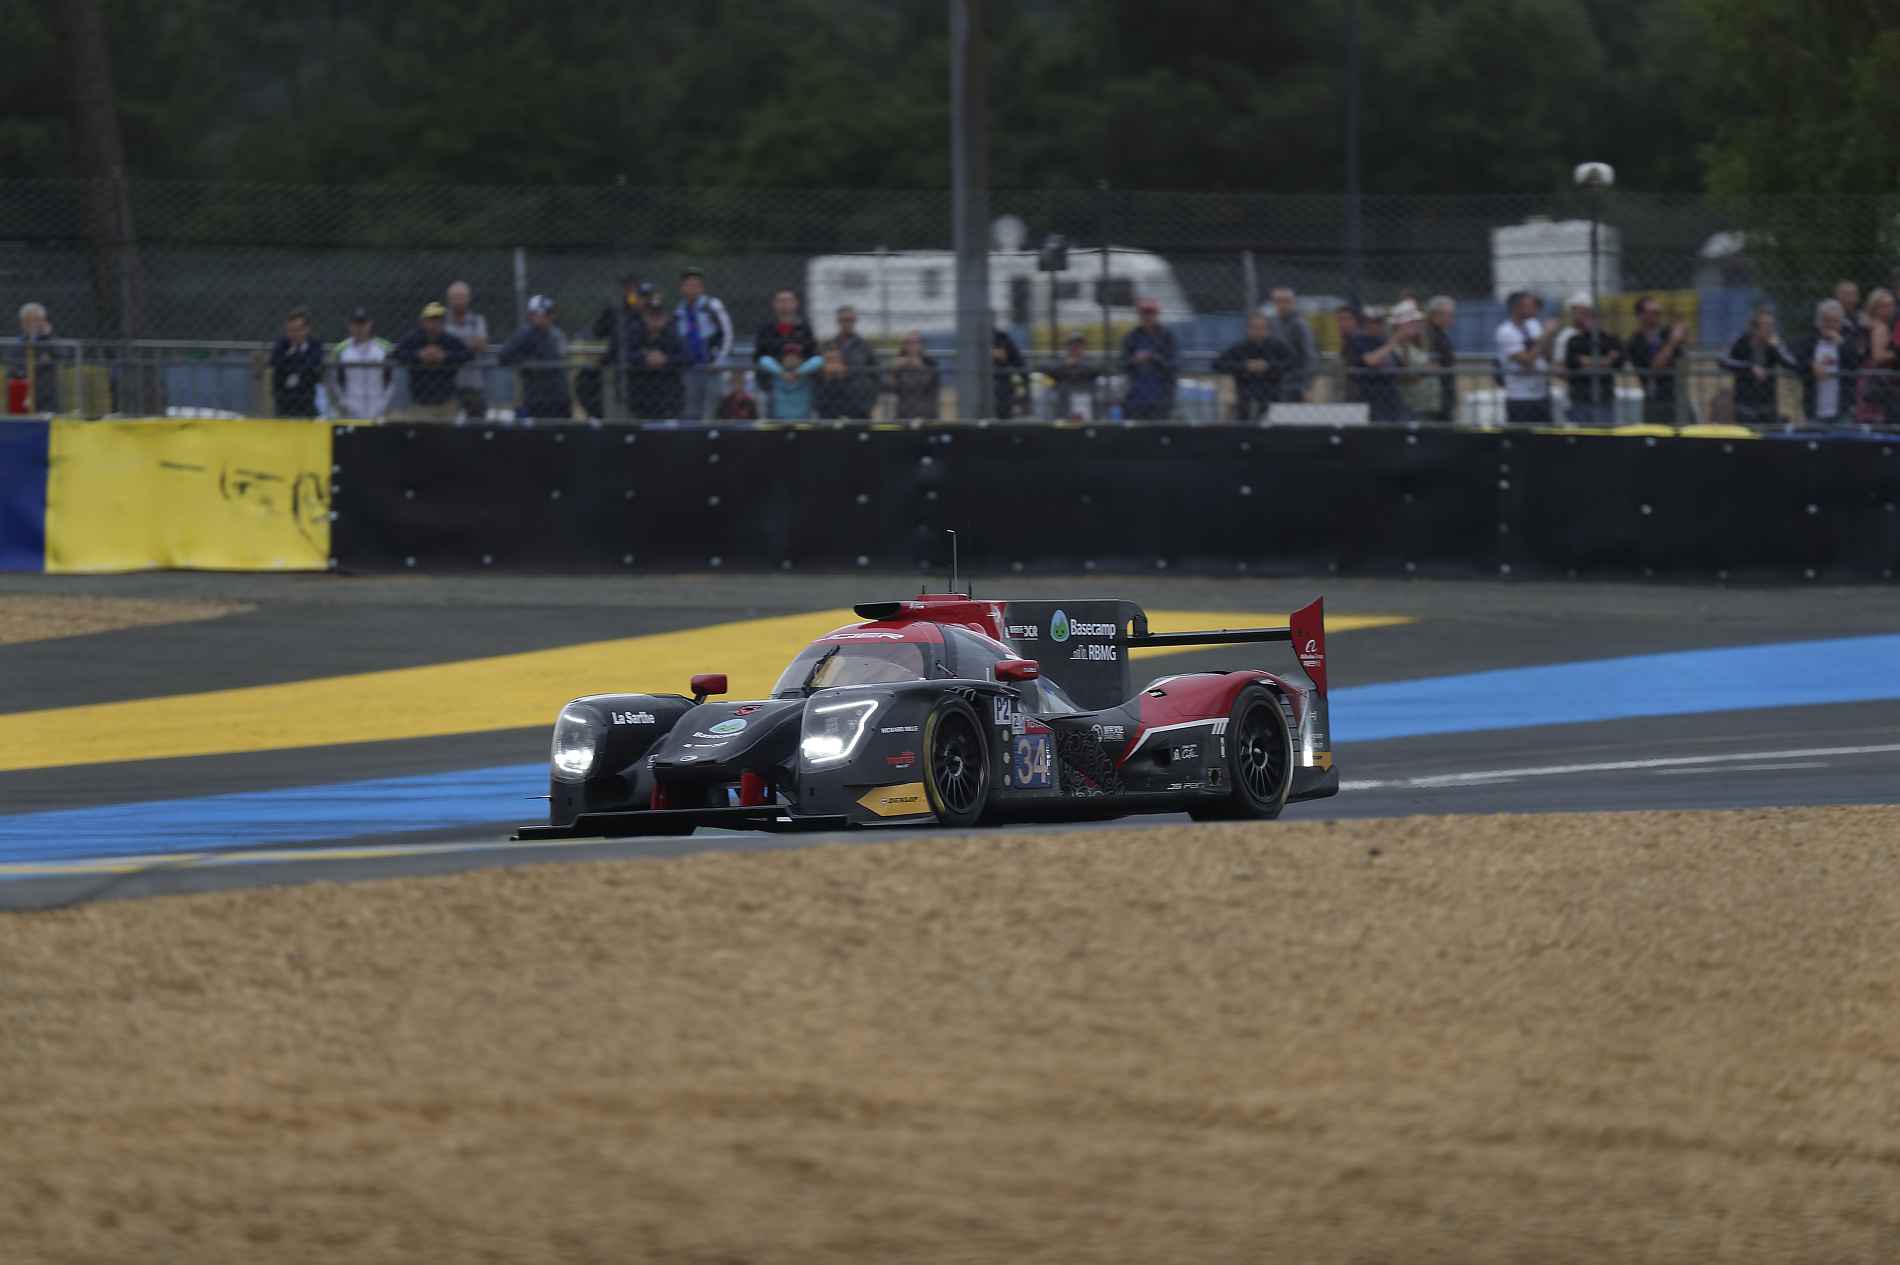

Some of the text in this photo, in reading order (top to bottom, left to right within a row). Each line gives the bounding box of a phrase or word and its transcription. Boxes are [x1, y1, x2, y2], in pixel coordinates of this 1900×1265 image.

[1070, 618, 1116, 639] Basecamp
[1088, 644, 1117, 661] RBMG
[611, 711, 656, 725] La Sarthe
[996, 696, 1009, 720] P2
[1018, 738, 1047, 784] 34
